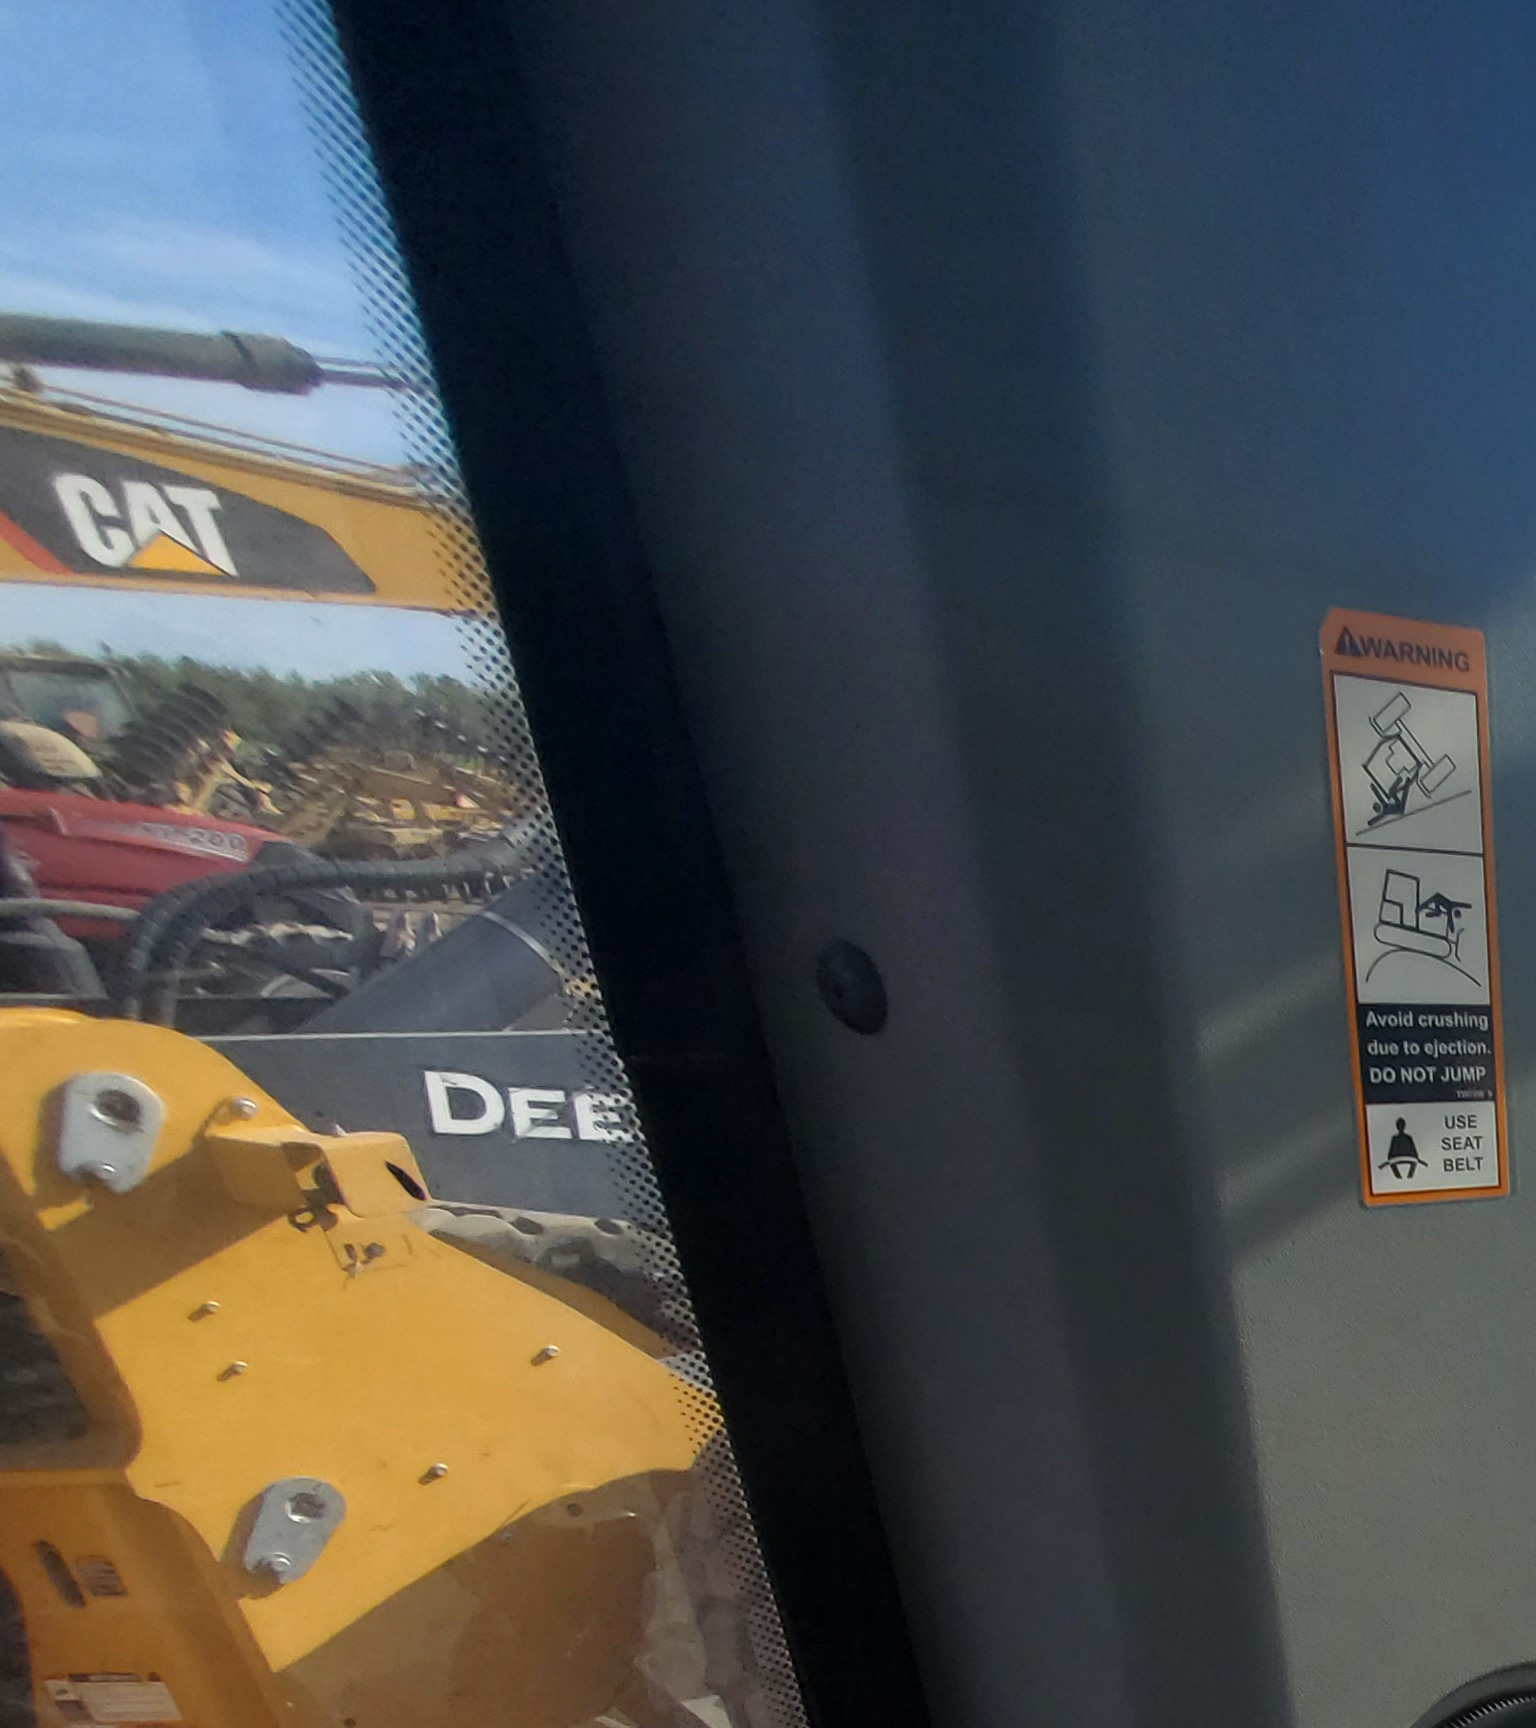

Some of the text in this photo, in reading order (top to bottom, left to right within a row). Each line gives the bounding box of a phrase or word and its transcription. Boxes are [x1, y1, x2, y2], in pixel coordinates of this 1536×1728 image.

[54, 473, 239, 577] CAT
[1360, 636, 1470, 672] WARNING
[1366, 1010, 1489, 1031] Avoid crushing
[1367, 1039, 1491, 1058] due to ejection.
[1370, 1066, 1486, 1083] DO NOT JUMP
[1444, 1115, 1477, 1129] USE
[1441, 1136, 1483, 1151] SEAT
[1443, 1157, 1483, 1172] BELT
